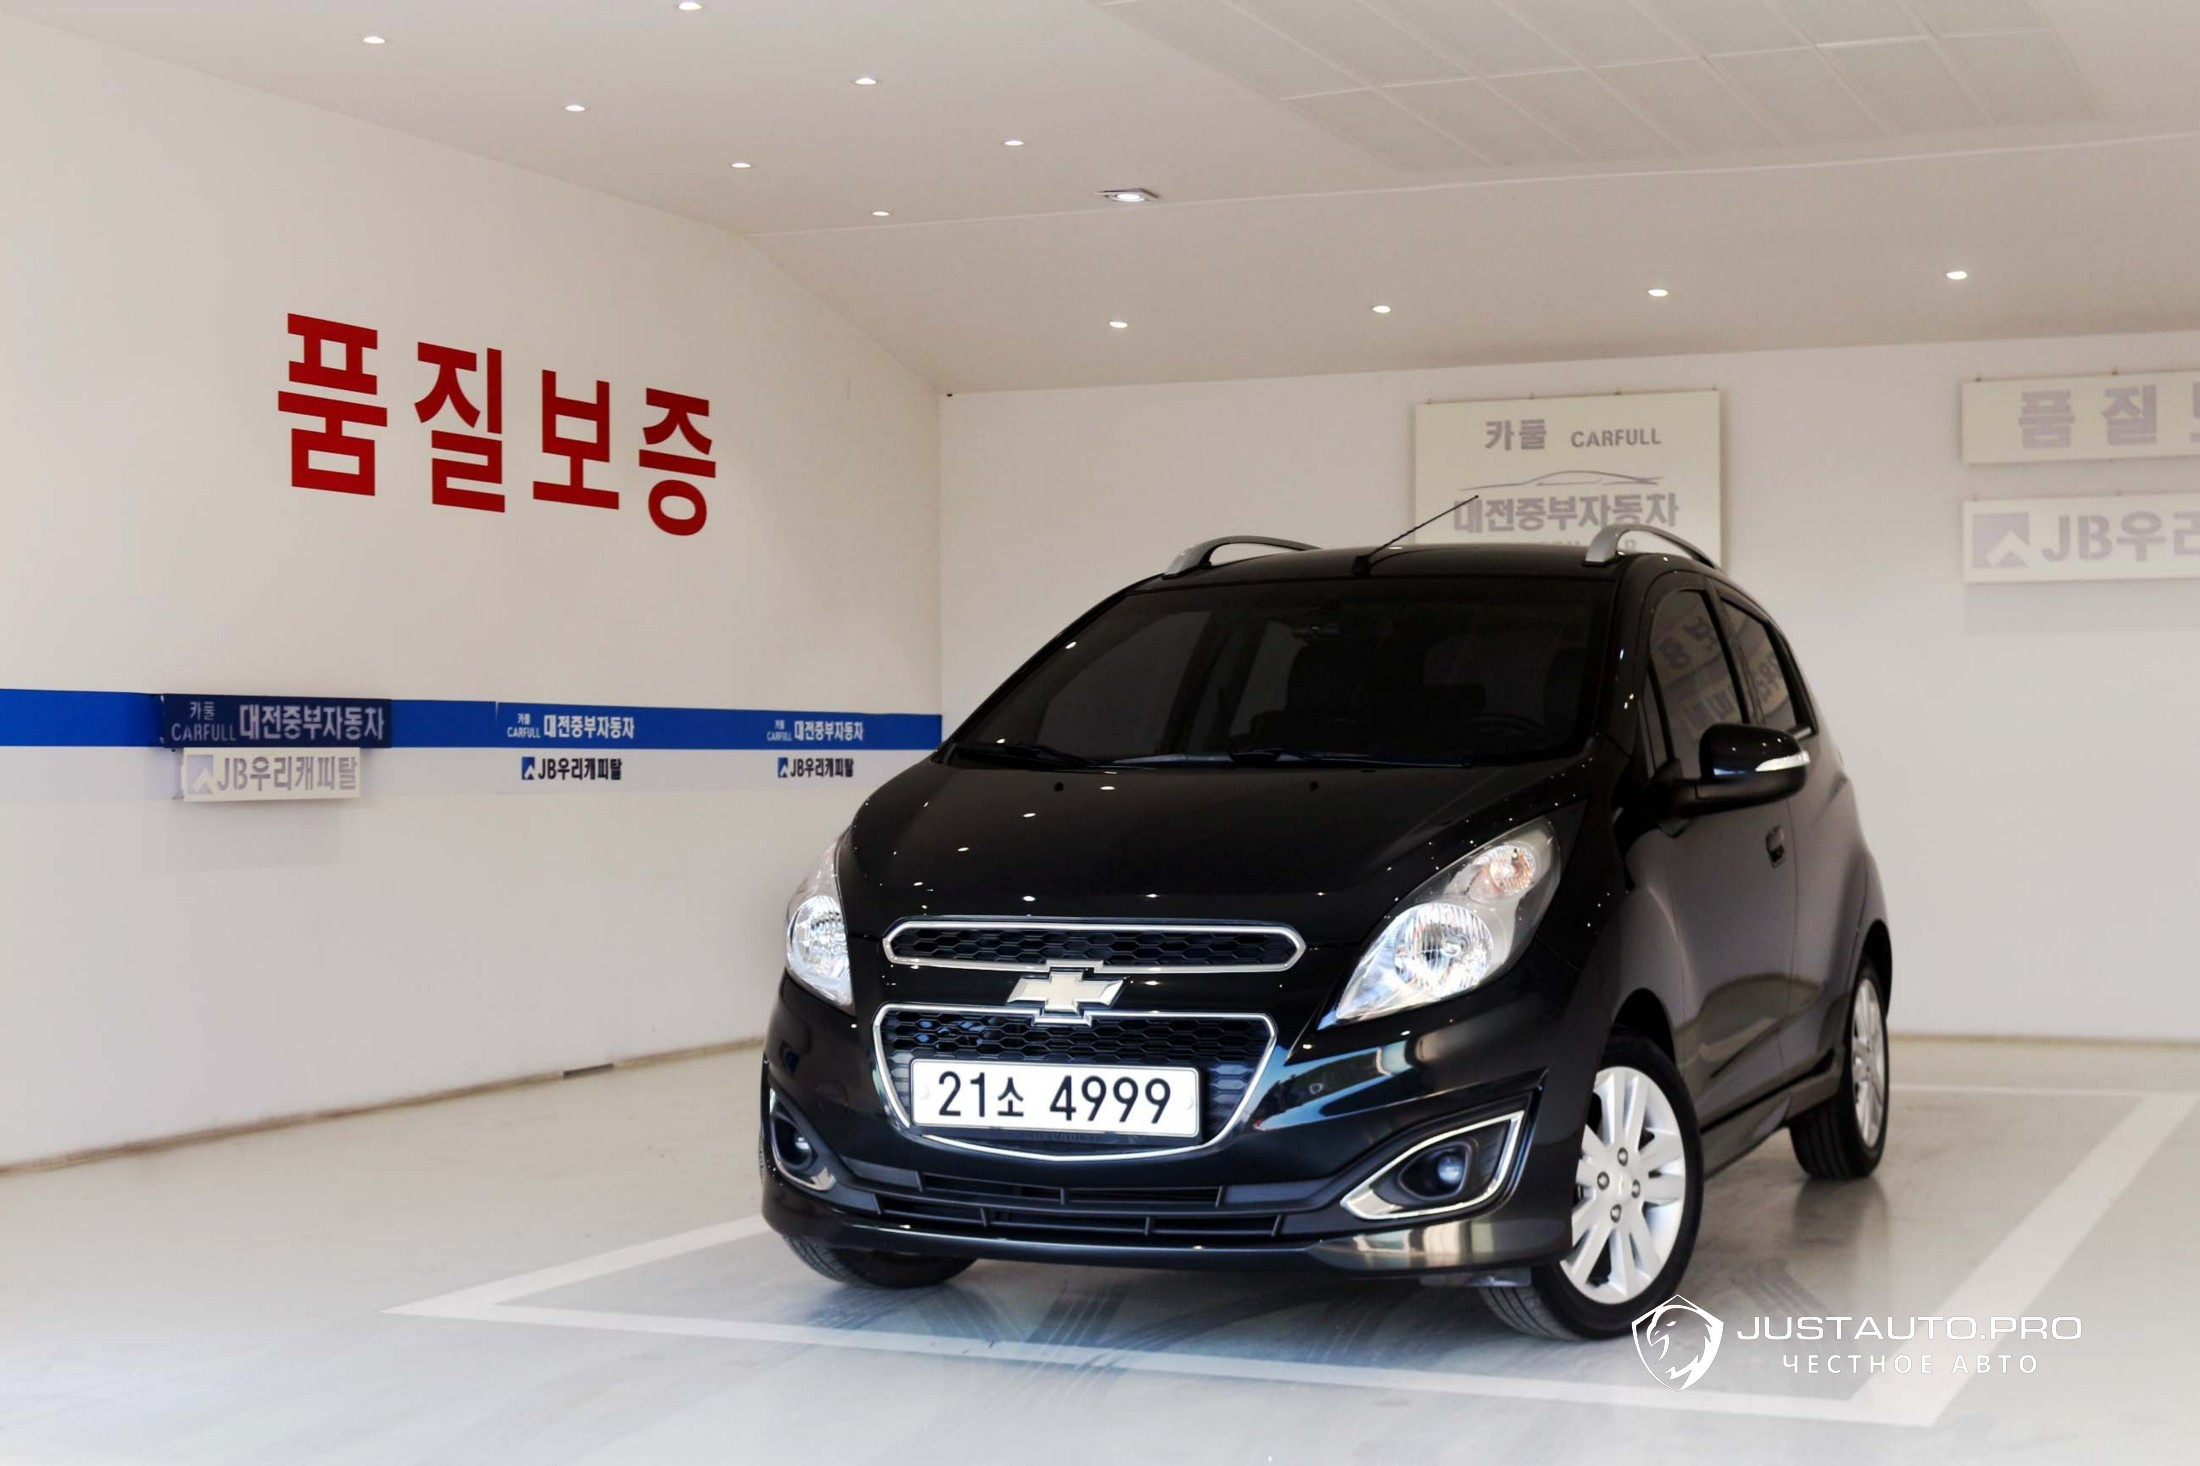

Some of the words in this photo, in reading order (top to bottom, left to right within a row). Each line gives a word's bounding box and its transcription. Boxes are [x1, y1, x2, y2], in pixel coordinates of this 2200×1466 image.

[277, 312, 717, 537] 품질보증
[2018, 382, 2200, 449] 품질
[1570, 427, 1663, 448] CARFULL
[1453, 492, 1680, 534] 대전중부자동차
[170, 722, 237, 742] CARFULL
[239, 704, 385, 741] 대전중부자동차
[506, 726, 541, 739] CARFULL
[543, 714, 636, 740] 대전중부자동차
[794, 719, 864, 742] 대전중부자동차
[217, 755, 358, 792] JB우리캐피탈
[538, 757, 622, 781] JB우리캐피탈
[790, 757, 855, 778] JB우리캐피탈
[938, 1070, 1025, 1118] 21소
[1049, 1074, 1172, 1125] 4999
